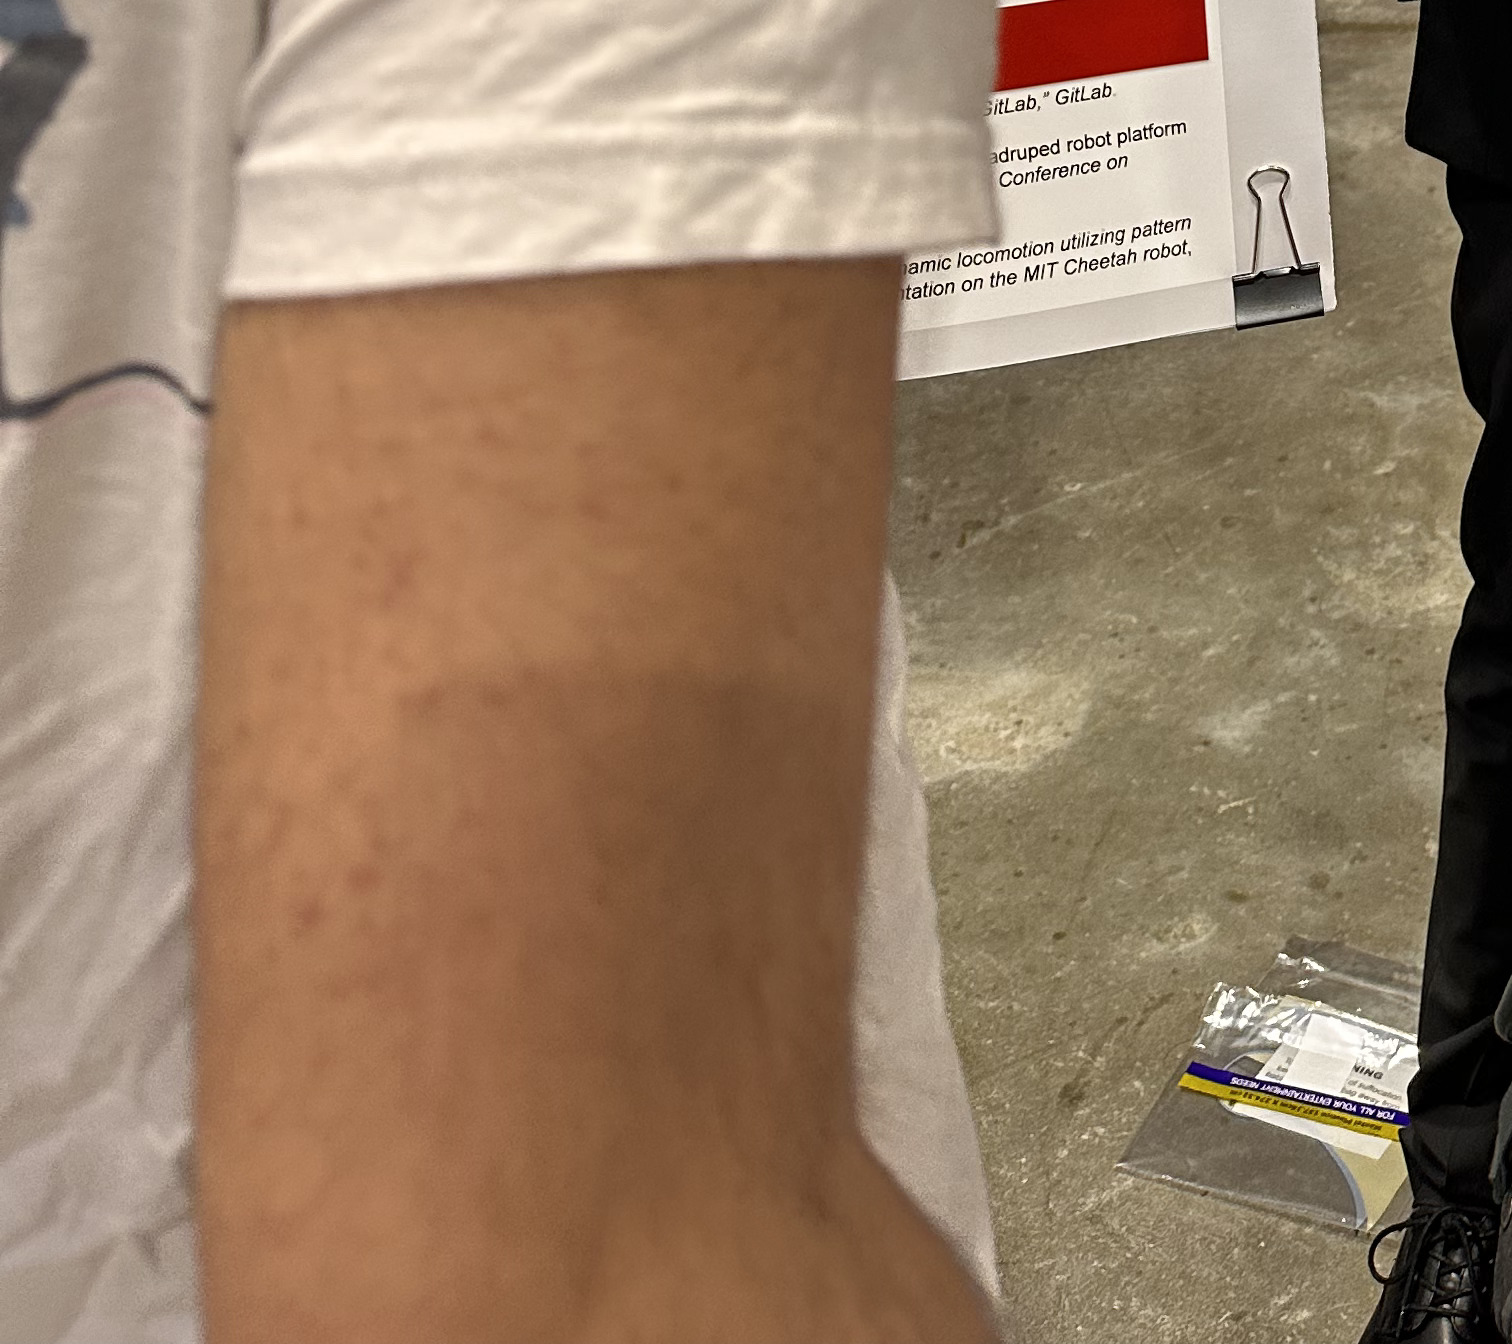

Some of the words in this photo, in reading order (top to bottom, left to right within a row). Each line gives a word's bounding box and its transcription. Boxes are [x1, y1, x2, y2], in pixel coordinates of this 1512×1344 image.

[1067, 131, 1112, 152] robot
[1117, 122, 1186, 148] platform
[999, 160, 1100, 187] Conference
[1106, 155, 1128, 170] on
[957, 241, 1054, 268] locomotion
[1060, 229, 1125, 251] utilizing
[1131, 218, 1191, 243] pattern
[961, 277, 983, 292] on
[990, 270, 1017, 288] the
[1024, 261, 1059, 282] MIT
[1064, 248, 1136, 275] Cheetah
[1143, 239, 1191, 261] robot,
[1332, 1099, 1356, 1111] YOUR
[1360, 1105, 1376, 1115] ALL
[1375, 1109, 1395, 1120] FOR
